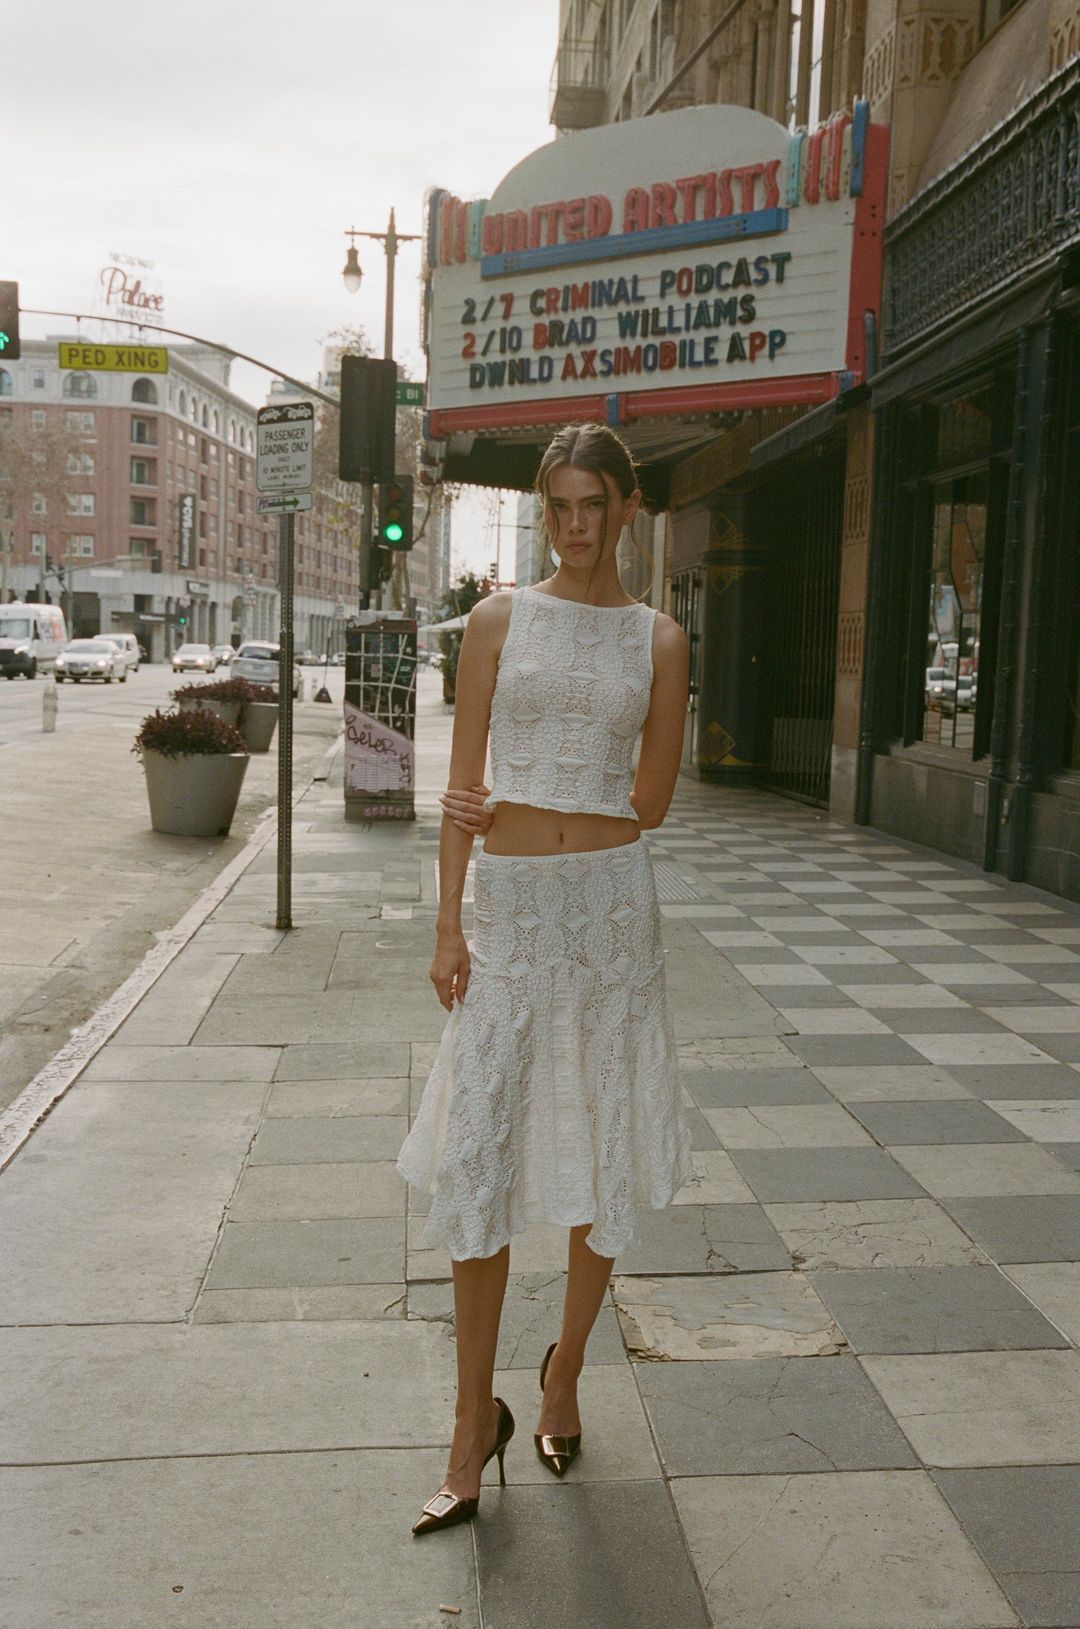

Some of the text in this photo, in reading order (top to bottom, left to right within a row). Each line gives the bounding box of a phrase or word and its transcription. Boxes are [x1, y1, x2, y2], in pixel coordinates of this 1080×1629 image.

[482, 159, 781, 256] UNITED ARTISTS
[100, 266, 165, 312] Palace
[461, 252, 792, 325] 2/7 CRIMINAL PODCAST
[461, 293, 757, 359] 2/10 BRAD WILLIAMS
[67, 347, 160, 369] PED XING
[469, 355, 554, 389] DWNLD
[726, 329, 787, 364] APP
[259, 440, 310, 456] LOADING ONLY
[264, 427, 306, 442] PASSENGER
